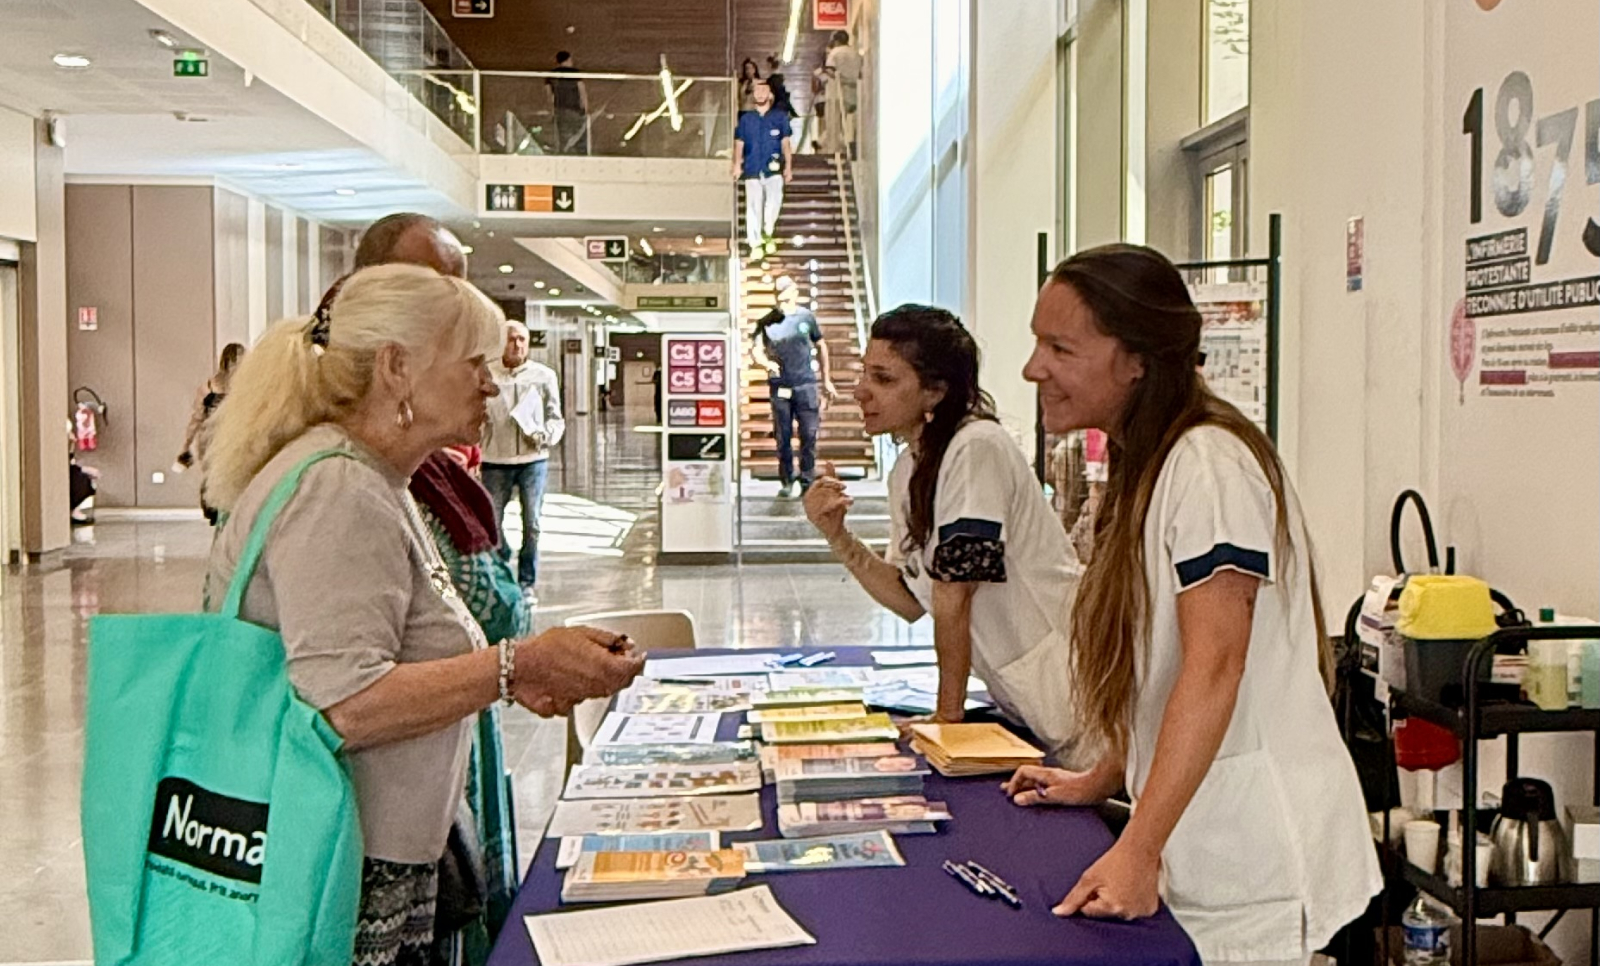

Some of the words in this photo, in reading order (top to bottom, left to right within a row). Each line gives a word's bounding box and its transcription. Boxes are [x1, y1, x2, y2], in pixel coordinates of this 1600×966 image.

[1466, 261, 1529, 287] PROTESTANTE
[671, 344, 694, 360] C3
[698, 344, 722, 361] C4
[671, 371, 695, 387] C5
[699, 368, 722, 384] C6
[163, 794, 267, 865] Norma
